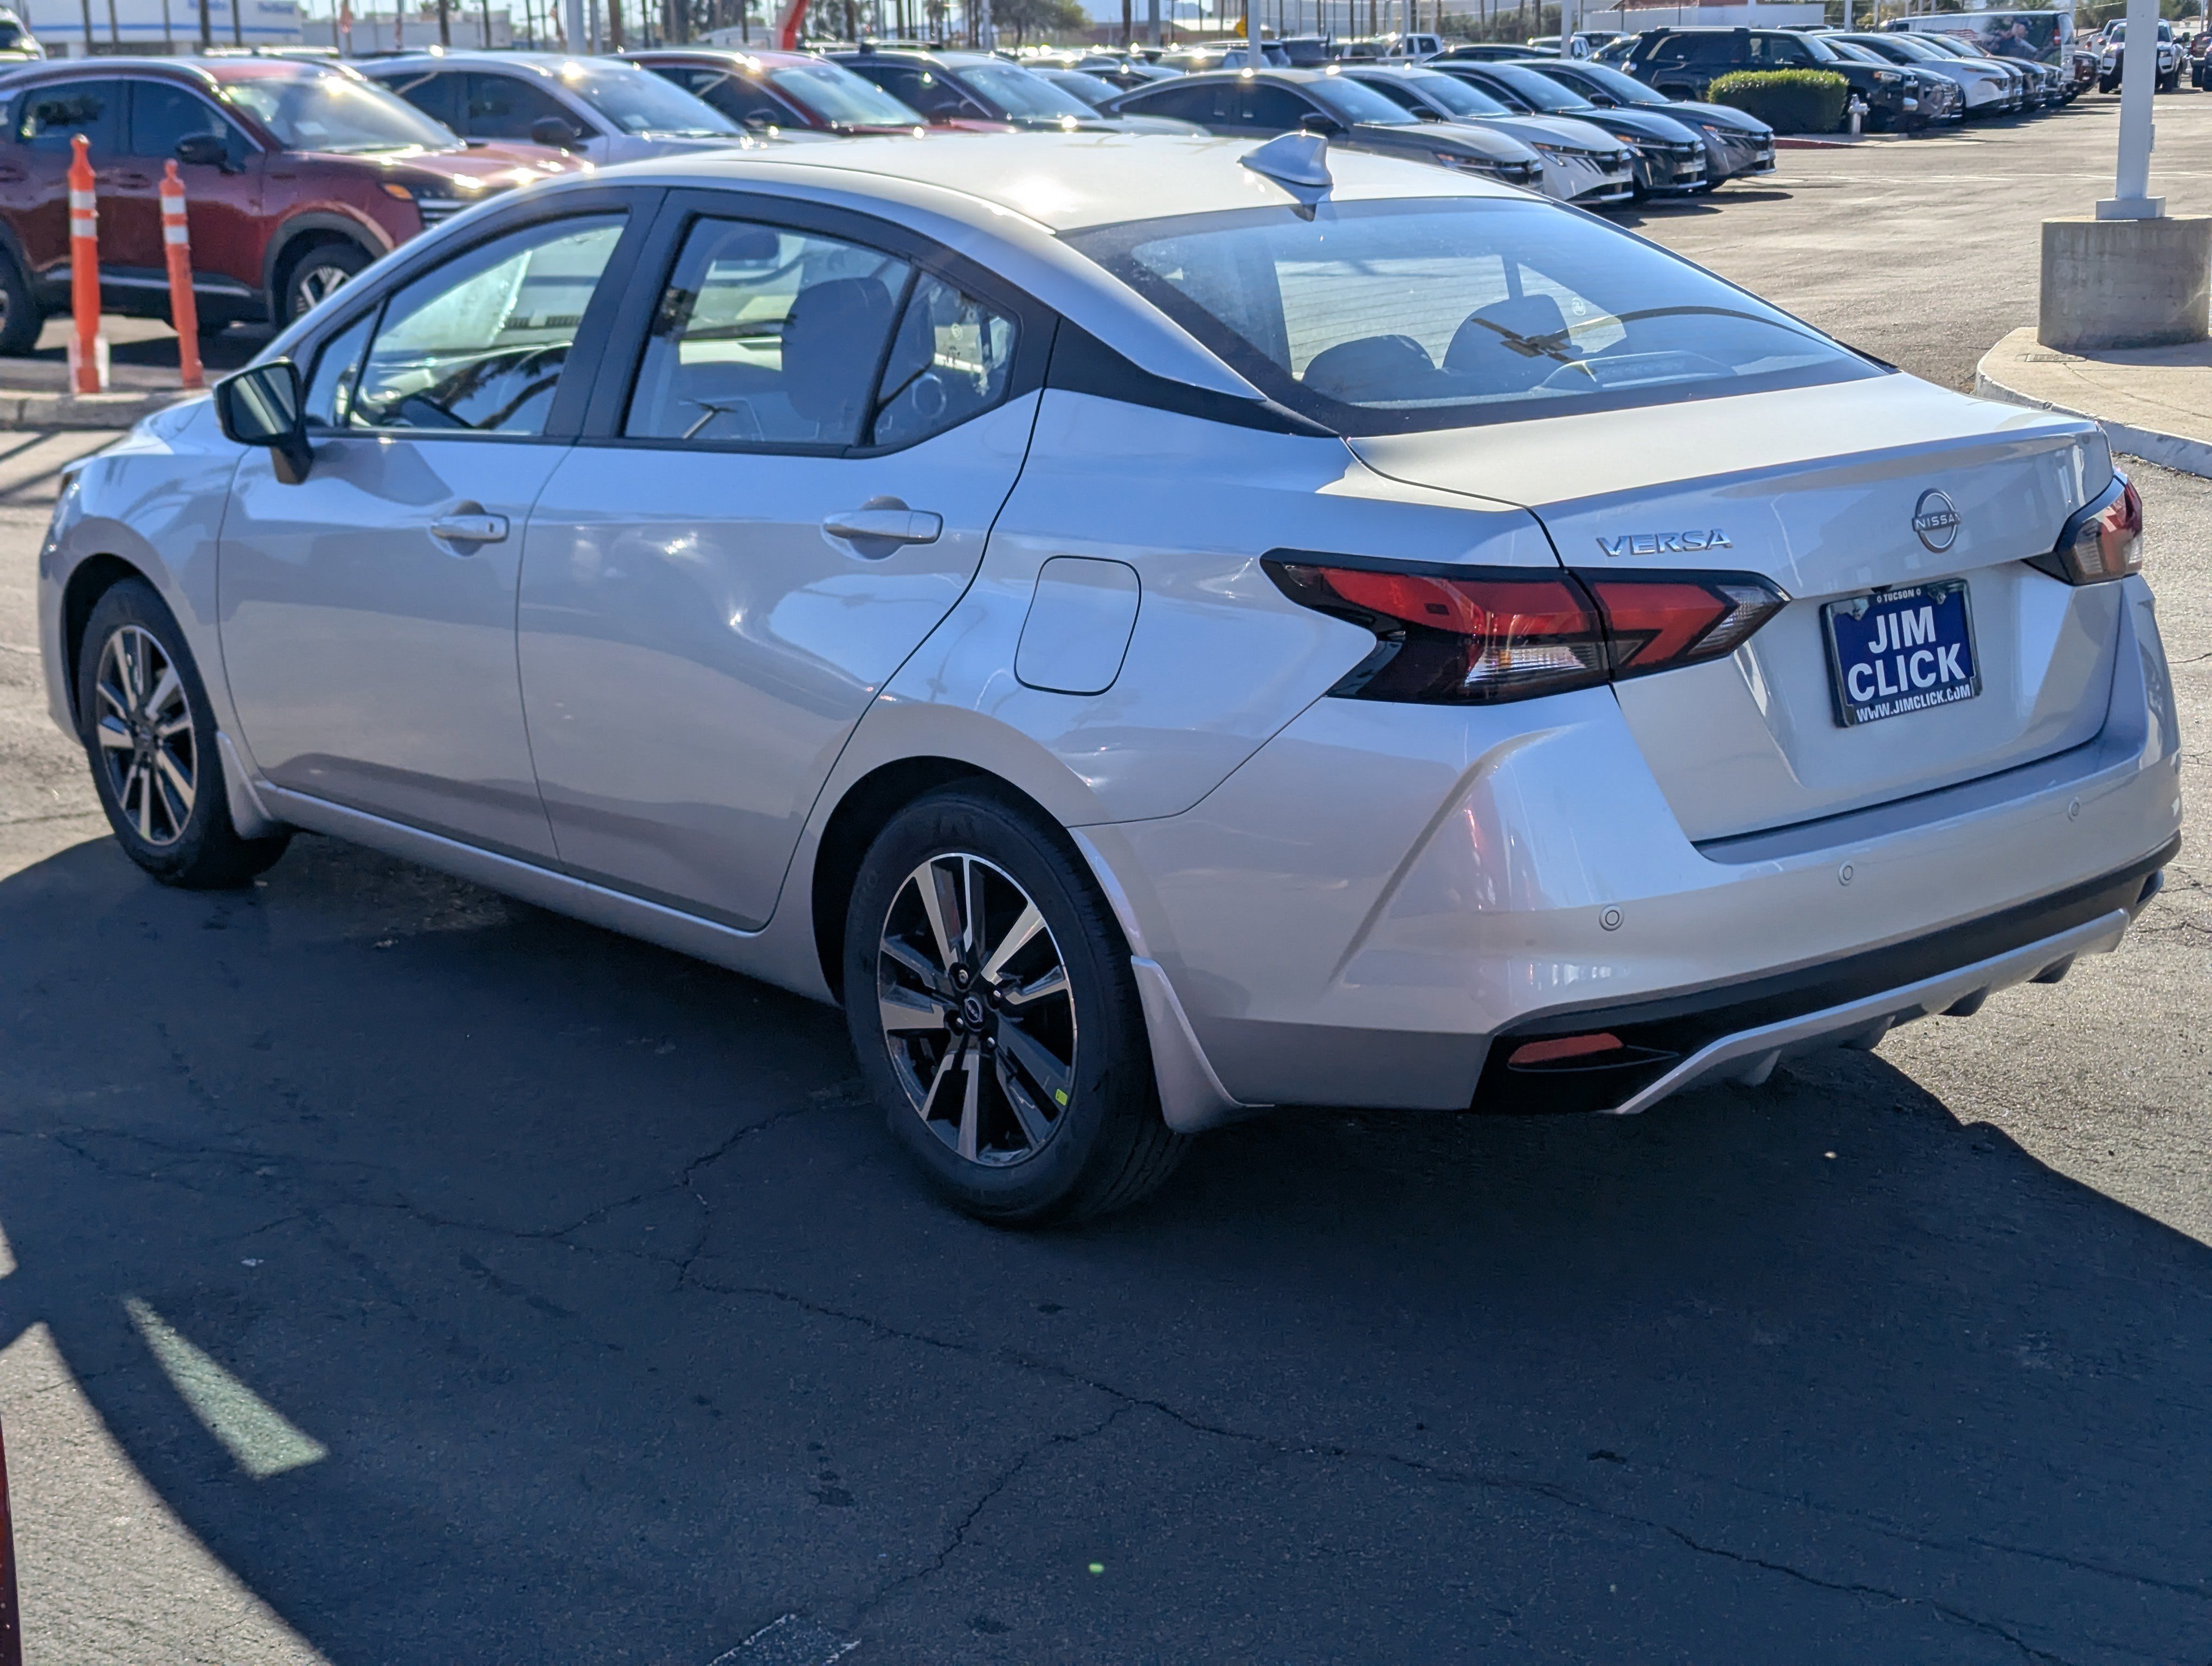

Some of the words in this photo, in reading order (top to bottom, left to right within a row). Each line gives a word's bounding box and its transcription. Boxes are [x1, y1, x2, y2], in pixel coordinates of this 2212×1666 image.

[1915, 514, 1957, 528] NISSA
[1596, 529, 1732, 557] VERSA
[1883, 589, 1915, 602] TUCSON
[1868, 606, 1936, 653] JIM
[1848, 643, 1966, 702] CLICK
[1856, 684, 1971, 722] WWW.JIMCLICK.COM
